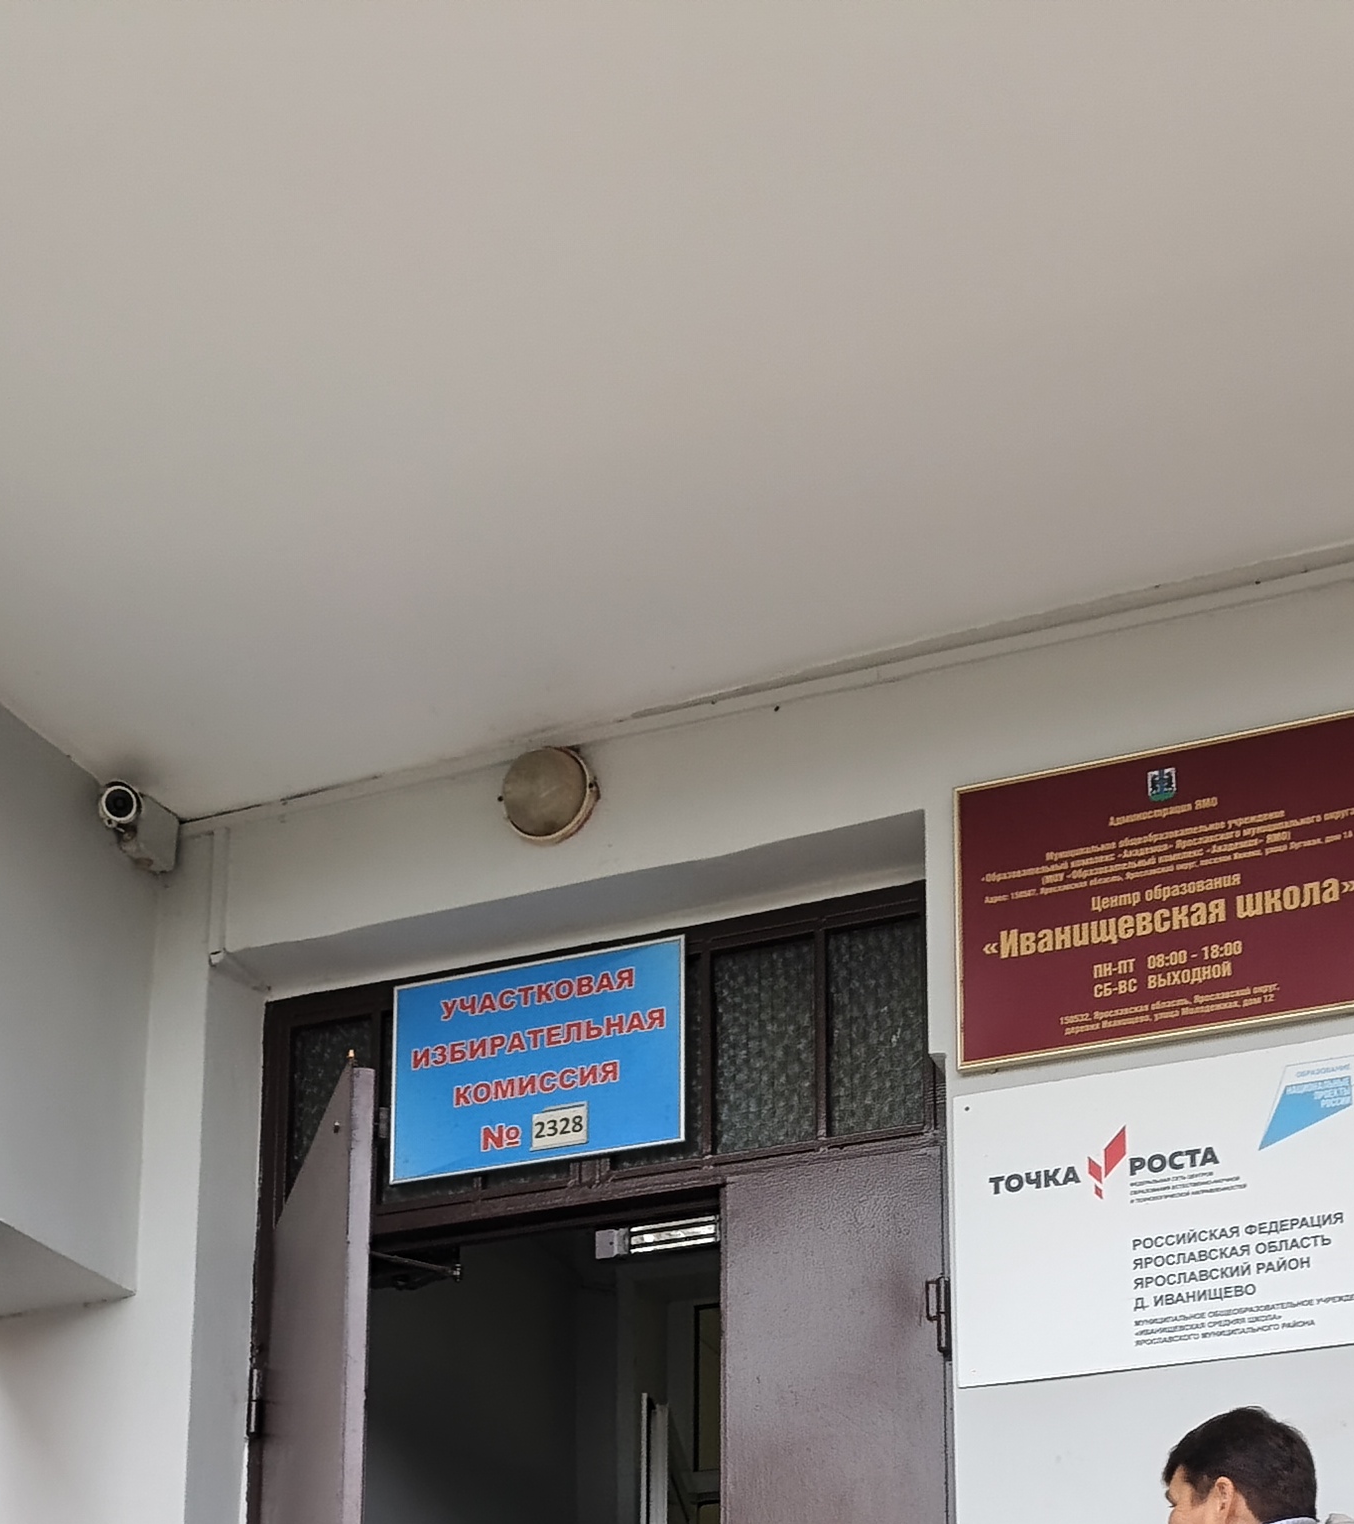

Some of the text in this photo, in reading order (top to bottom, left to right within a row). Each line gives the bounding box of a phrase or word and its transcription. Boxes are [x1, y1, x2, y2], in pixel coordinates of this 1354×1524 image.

[1091, 873, 1241, 911] Центр образования
[983, 899, 1226, 959] «Иванищевская
[1093, 958, 1136, 978] ПН-ПТ
[1147, 950, 1187, 969] 08:00
[1202, 940, 1243, 960] 18:00
[441, 968, 635, 1020] УЧАСТКОВАЯ
[1094, 961, 1232, 998] СБ-ВС ВЫХОДНОЙ
[411, 1008, 666, 1070] ИЗБИРАТЕЛЬНАЯ
[454, 1061, 620, 1107] КОМИССИЯ
[480, 1116, 584, 1151] № 2328
[988, 1146, 1220, 1195] ТОЧКА РОСТА
[1132, 1212, 1344, 1251] РОССИЙСКАЯ ФЕДЕРАЦИЯ
[1132, 1234, 1332, 1270] ЯРОСЛАВСКАЯ ОБЛАСТЬ
[1133, 1256, 1311, 1290] ЯРОСЛАВСКИЙ РАЙОН
[1133, 1284, 1257, 1311] Д. ИВАНИЩЕВО
